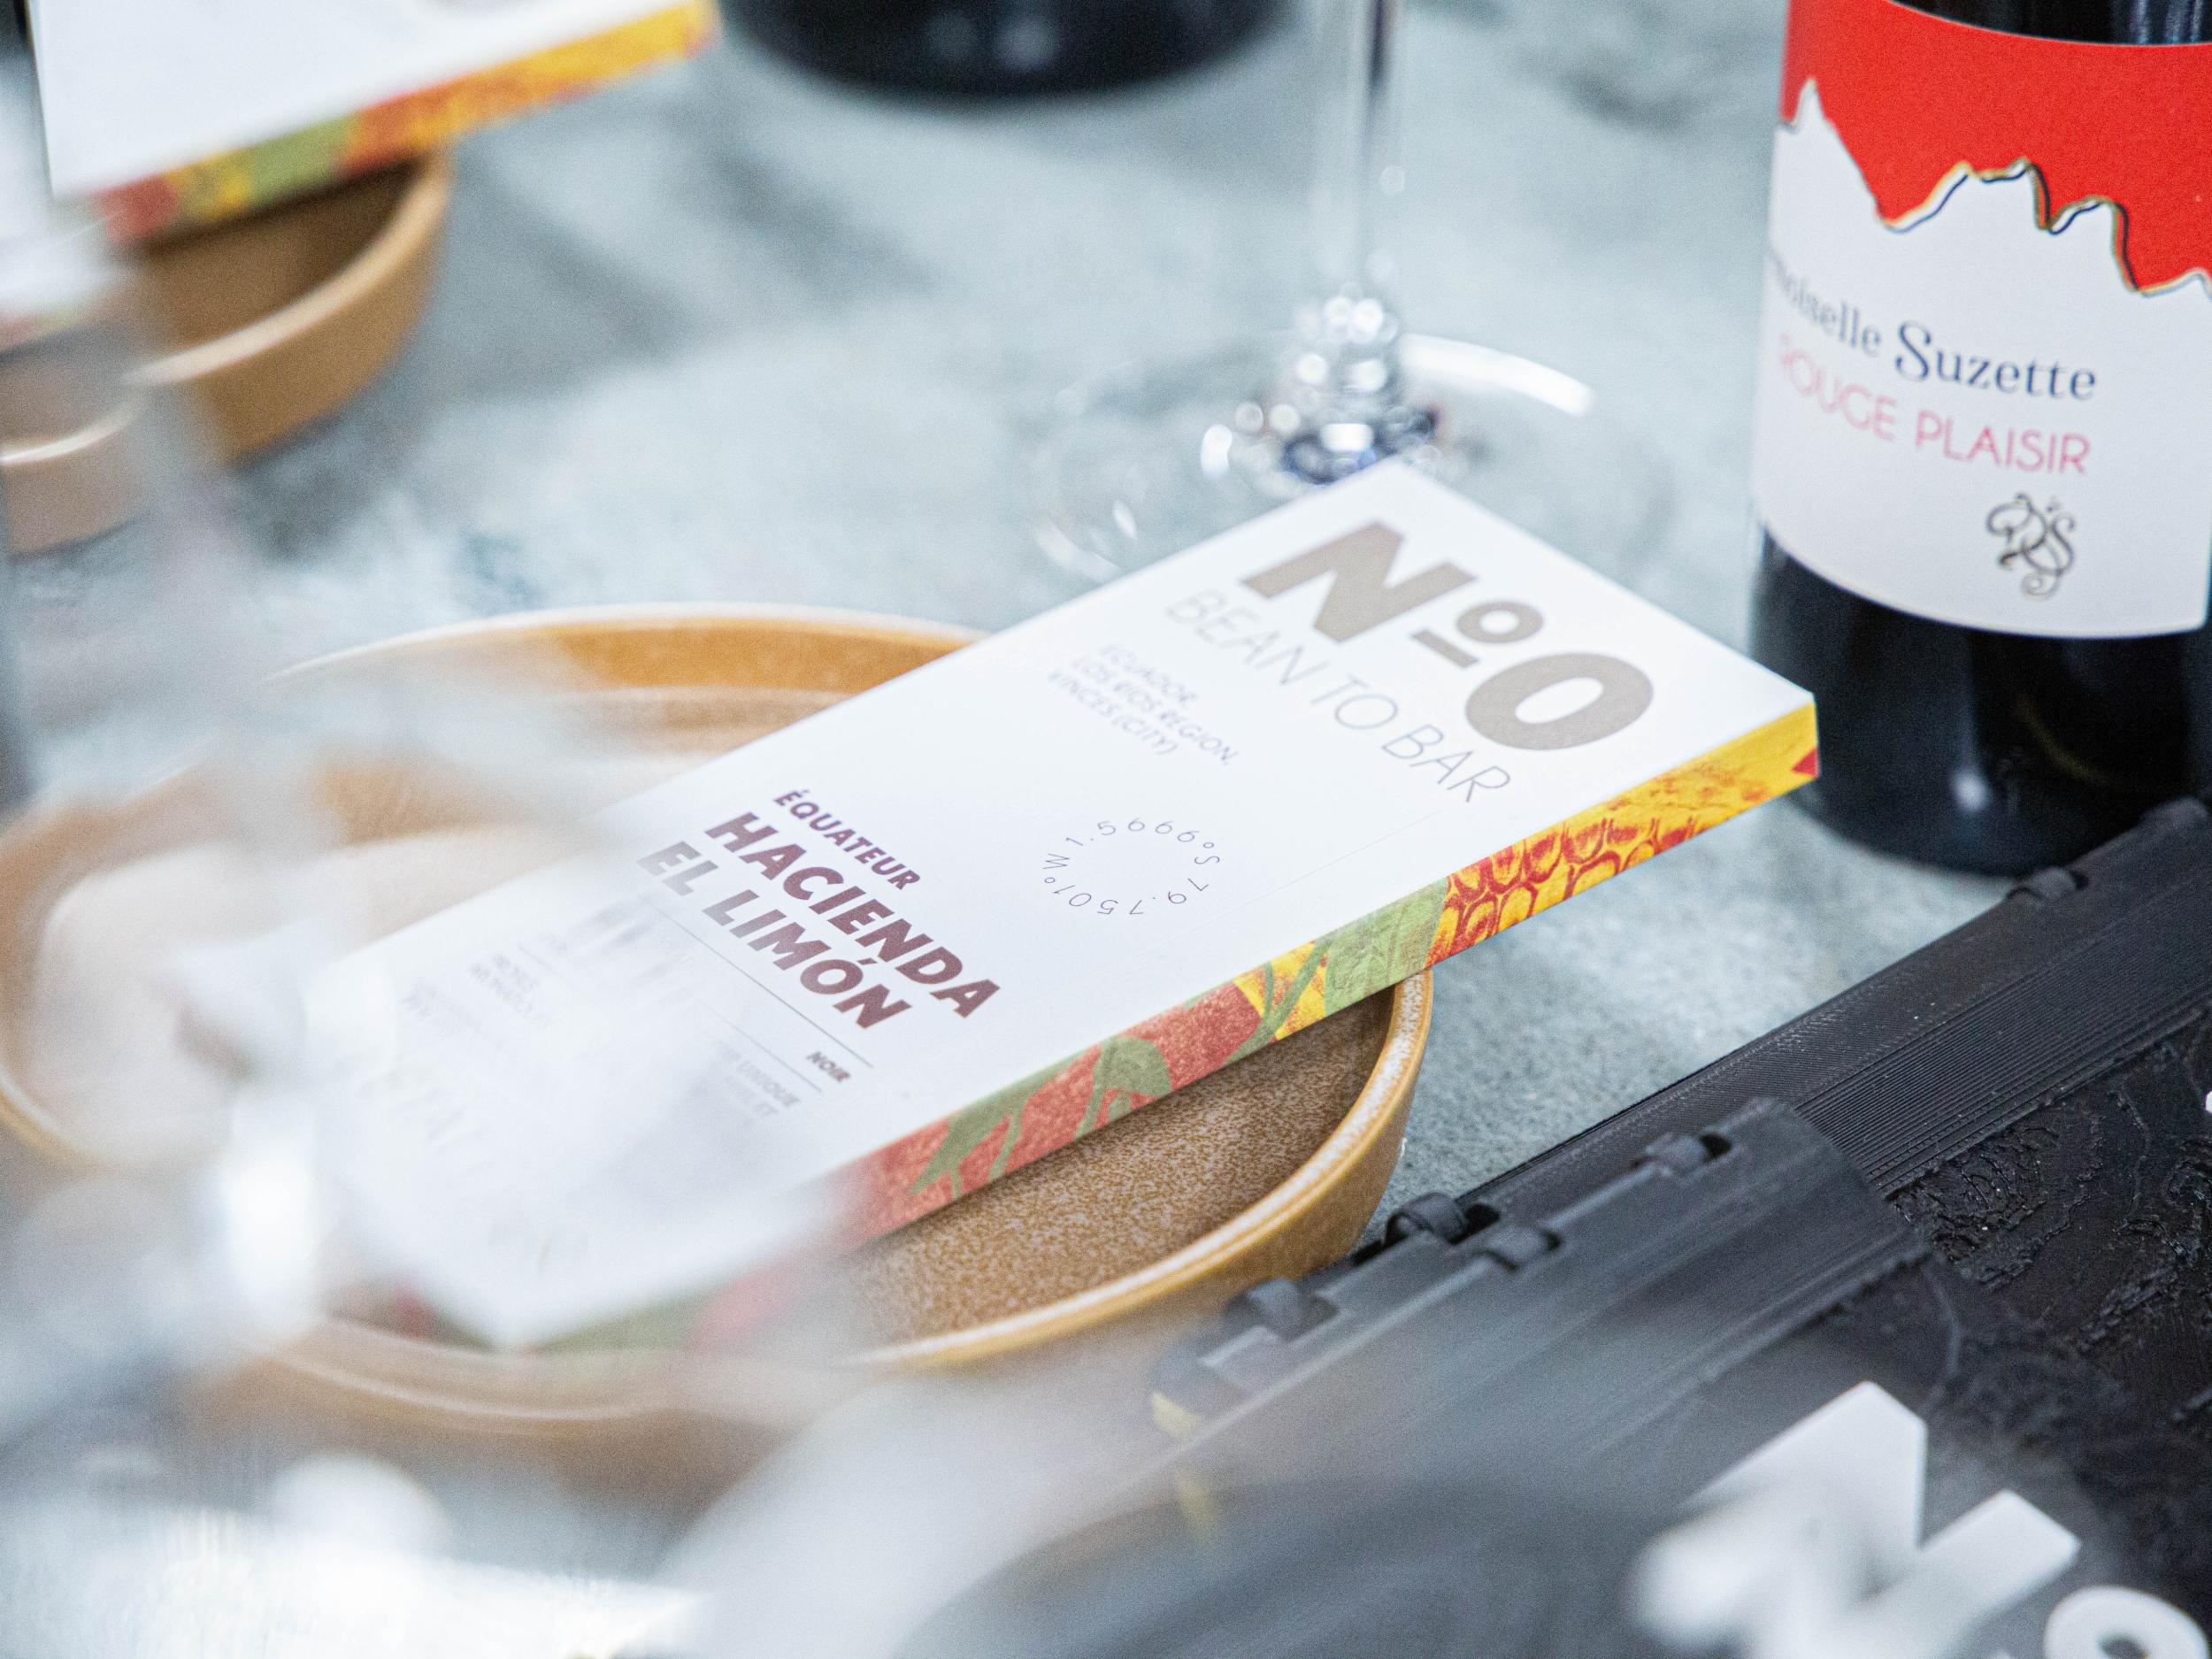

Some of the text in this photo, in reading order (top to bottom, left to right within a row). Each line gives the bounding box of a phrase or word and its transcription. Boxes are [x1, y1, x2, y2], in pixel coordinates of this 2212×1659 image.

[1895, 320, 2097, 401] Suzette
[1914, 410, 2093, 477] PLAISIR
[1164, 588, 1512, 804] BEAN TO BAR
[774, 788, 922, 891] ÉQUATEUR
[635, 841, 913, 1030] EL LIMÓN
[704, 811, 1001, 1019] HACIENDA
[806, 1050, 851, 1083] NOIR
